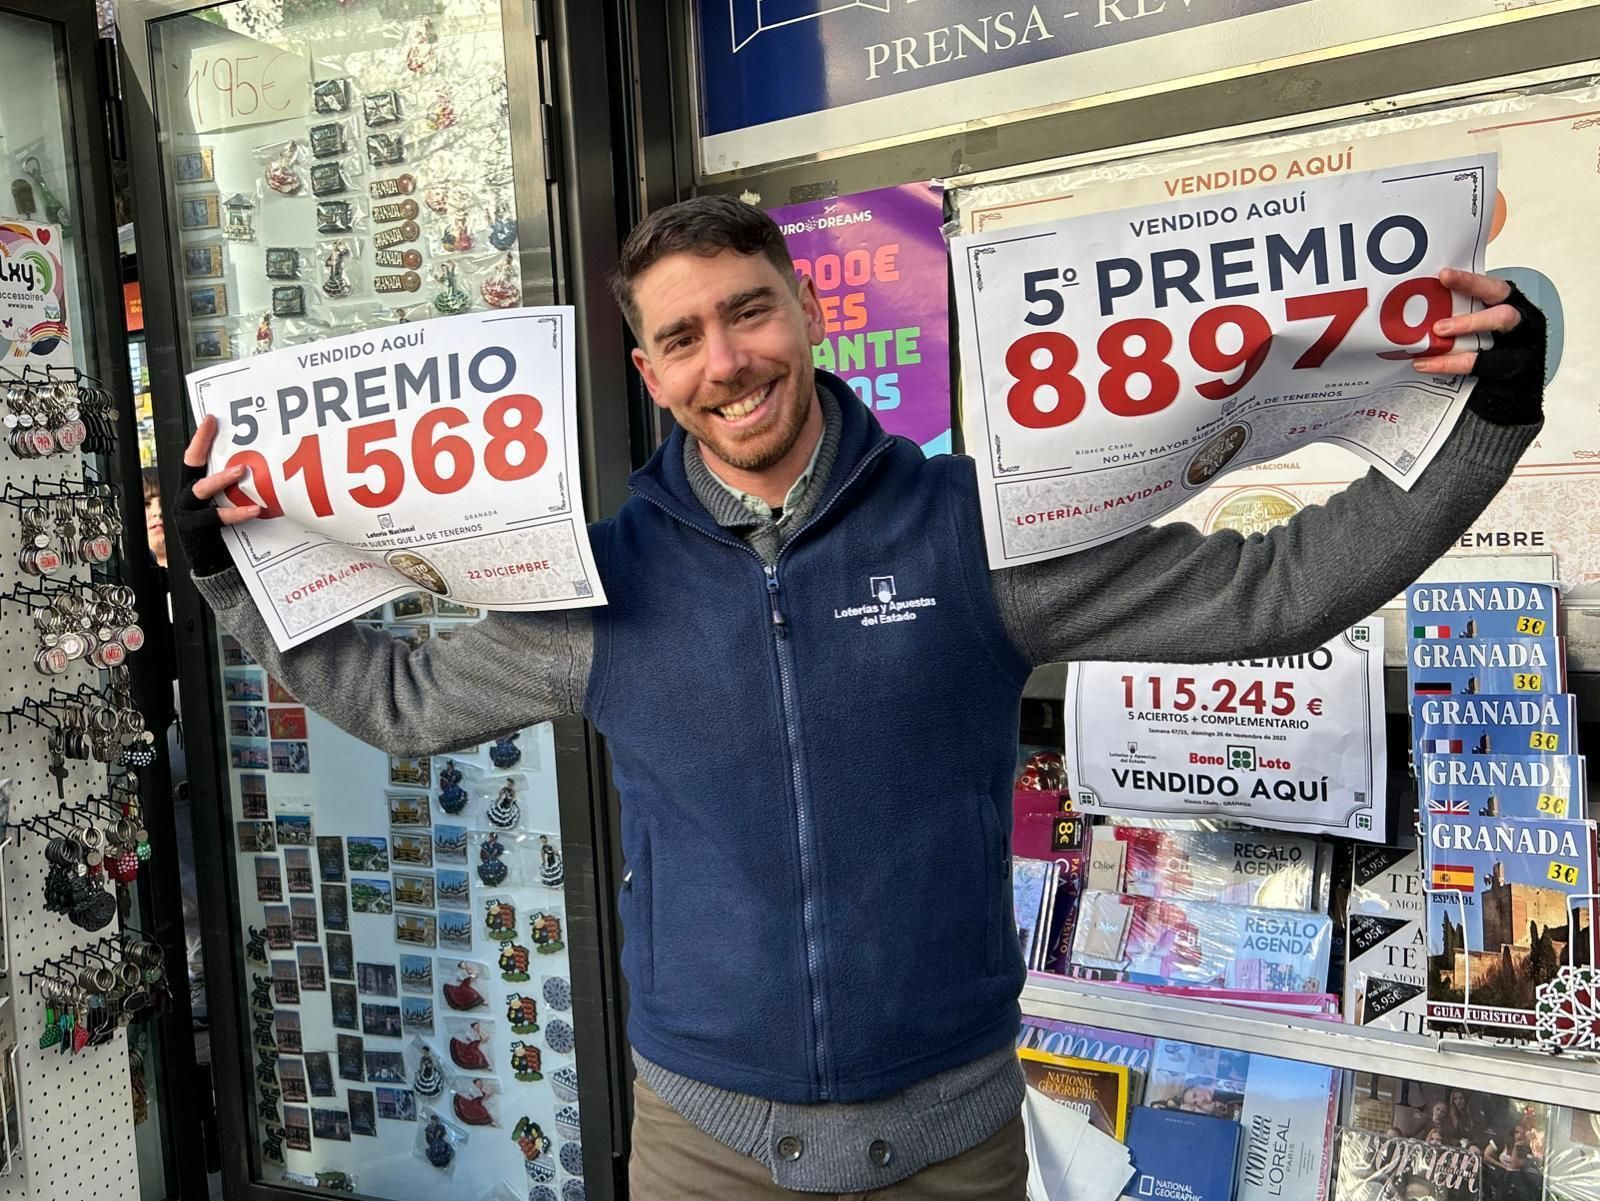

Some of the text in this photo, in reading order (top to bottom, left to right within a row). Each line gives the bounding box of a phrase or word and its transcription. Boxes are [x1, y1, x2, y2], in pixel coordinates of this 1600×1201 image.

[864, 11, 1055, 82] PRENSA
[1165, 147, 1354, 198] VENDIDO AQUÍ
[779, 209, 873, 236] URO DREAMS
[1130, 191, 1307, 238] VENDIDO AQUÍ
[792, 243, 899, 291] 00€
[1096, 215, 1429, 317] PREMIO
[0, 292, 44, 301] ccessoires
[824, 292, 869, 334] ES
[298, 328, 426, 370] VENDIDO AQUÍ
[811, 327, 921, 373] ANTE
[1005, 277, 1457, 431] 88979
[275, 345, 517, 435] PREMIO
[1324, 381, 1370, 389] GRANADA
[1103, 455, 1120, 464] NO
[1123, 450, 1146, 460] HAY
[1149, 439, 1189, 455] MAYOR
[1264, 396, 1279, 404] DE
[1282, 390, 1343, 401] TENERNOS
[1288, 426, 1306, 435] 22
[223, 393, 549, 520] 01568
[464, 510, 498, 521] GRANADA
[1016, 504, 1083, 527] LOTERÍA
[1103, 479, 1174, 510] NAVIDAD
[367, 538, 396, 548] SUERTE
[396, 536, 414, 546] QUE
[414, 535, 425, 543] LA
[426, 532, 438, 541] DE
[438, 523, 483, 538] TENERNOS
[1460, 531, 1545, 548] EMBRE
[467, 559, 551, 580] 22 DICIEMBRE
[285, 574, 338, 605] LOTERÍA
[1412, 587, 1546, 612] GRANADA
[834, 597, 937, 619] Loterías y Apuestas
[861, 611, 917, 627] del Estado
[1413, 643, 1548, 669] GRANADA
[1120, 675, 1323, 716] 115.245 €
[1128, 711, 1135, 720] 5
[1137, 711, 1189, 723] ACIERTOS
[1201, 714, 1309, 729] COMPLEMENTARIO
[1421, 699, 1561, 726] GRANADA
[1188, 752, 1291, 770] Bono Loto
[1428, 760, 1571, 787] GRANADA
[1111, 768, 1330, 802] VENDIDO AQUÍ
[1233, 843, 1302, 862] REGALO
[1432, 823, 1580, 857] GRANADA
[1232, 861, 1299, 876] AGEN
[1245, 917, 1318, 938] REGALO
[1356, 924, 1385, 949] 5,95€
[1243, 936, 1313, 957] AGENDA
[1371, 989, 1402, 1013] 5,95€
[1433, 1006, 1528, 1025] GUÍA TURÍSTICA
[1038, 1080, 1099, 1101] GEOGRAPHIC
[1047, 1071, 1094, 1089] NATIONAL
[1155, 1179, 1193, 1194] NATIONAL
